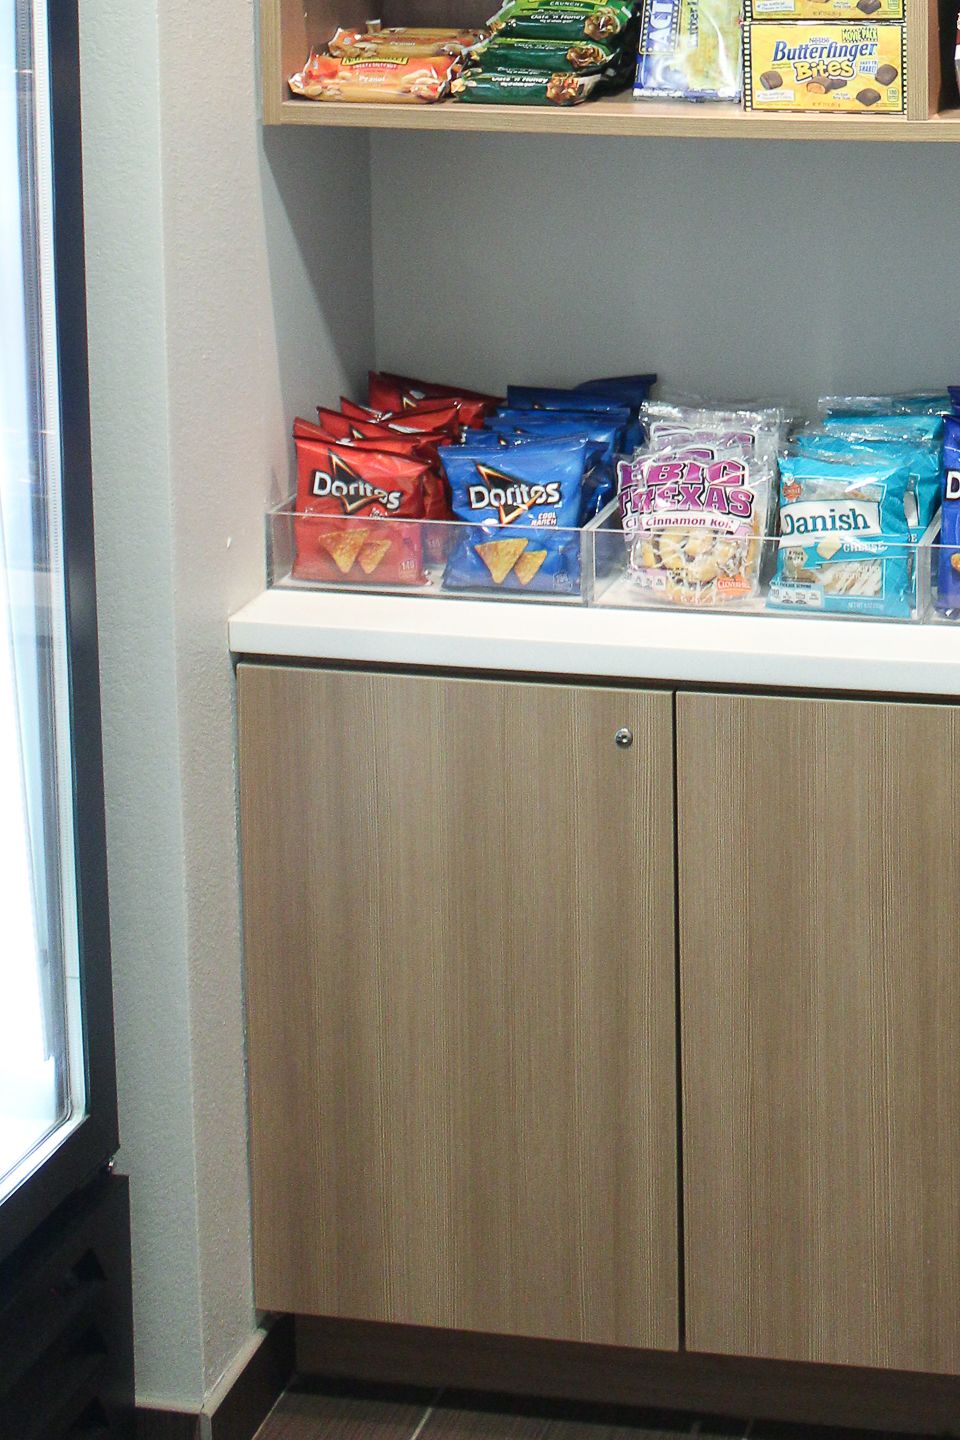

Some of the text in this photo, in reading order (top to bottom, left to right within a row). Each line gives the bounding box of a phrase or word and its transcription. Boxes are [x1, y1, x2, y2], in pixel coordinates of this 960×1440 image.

[648, 0, 673, 45] ACT
[772, 40, 877, 61] Butterfinger
[793, 59, 855, 82] Bites
[647, 460, 745, 486] BIG
[313, 471, 402, 509] Doritos
[469, 481, 562, 509] Doritos
[632, 485, 754, 517] TEXAS
[537, 511, 557, 520] COOL
[645, 516, 706, 528] Cinnamon
[781, 508, 871, 536] Danish
